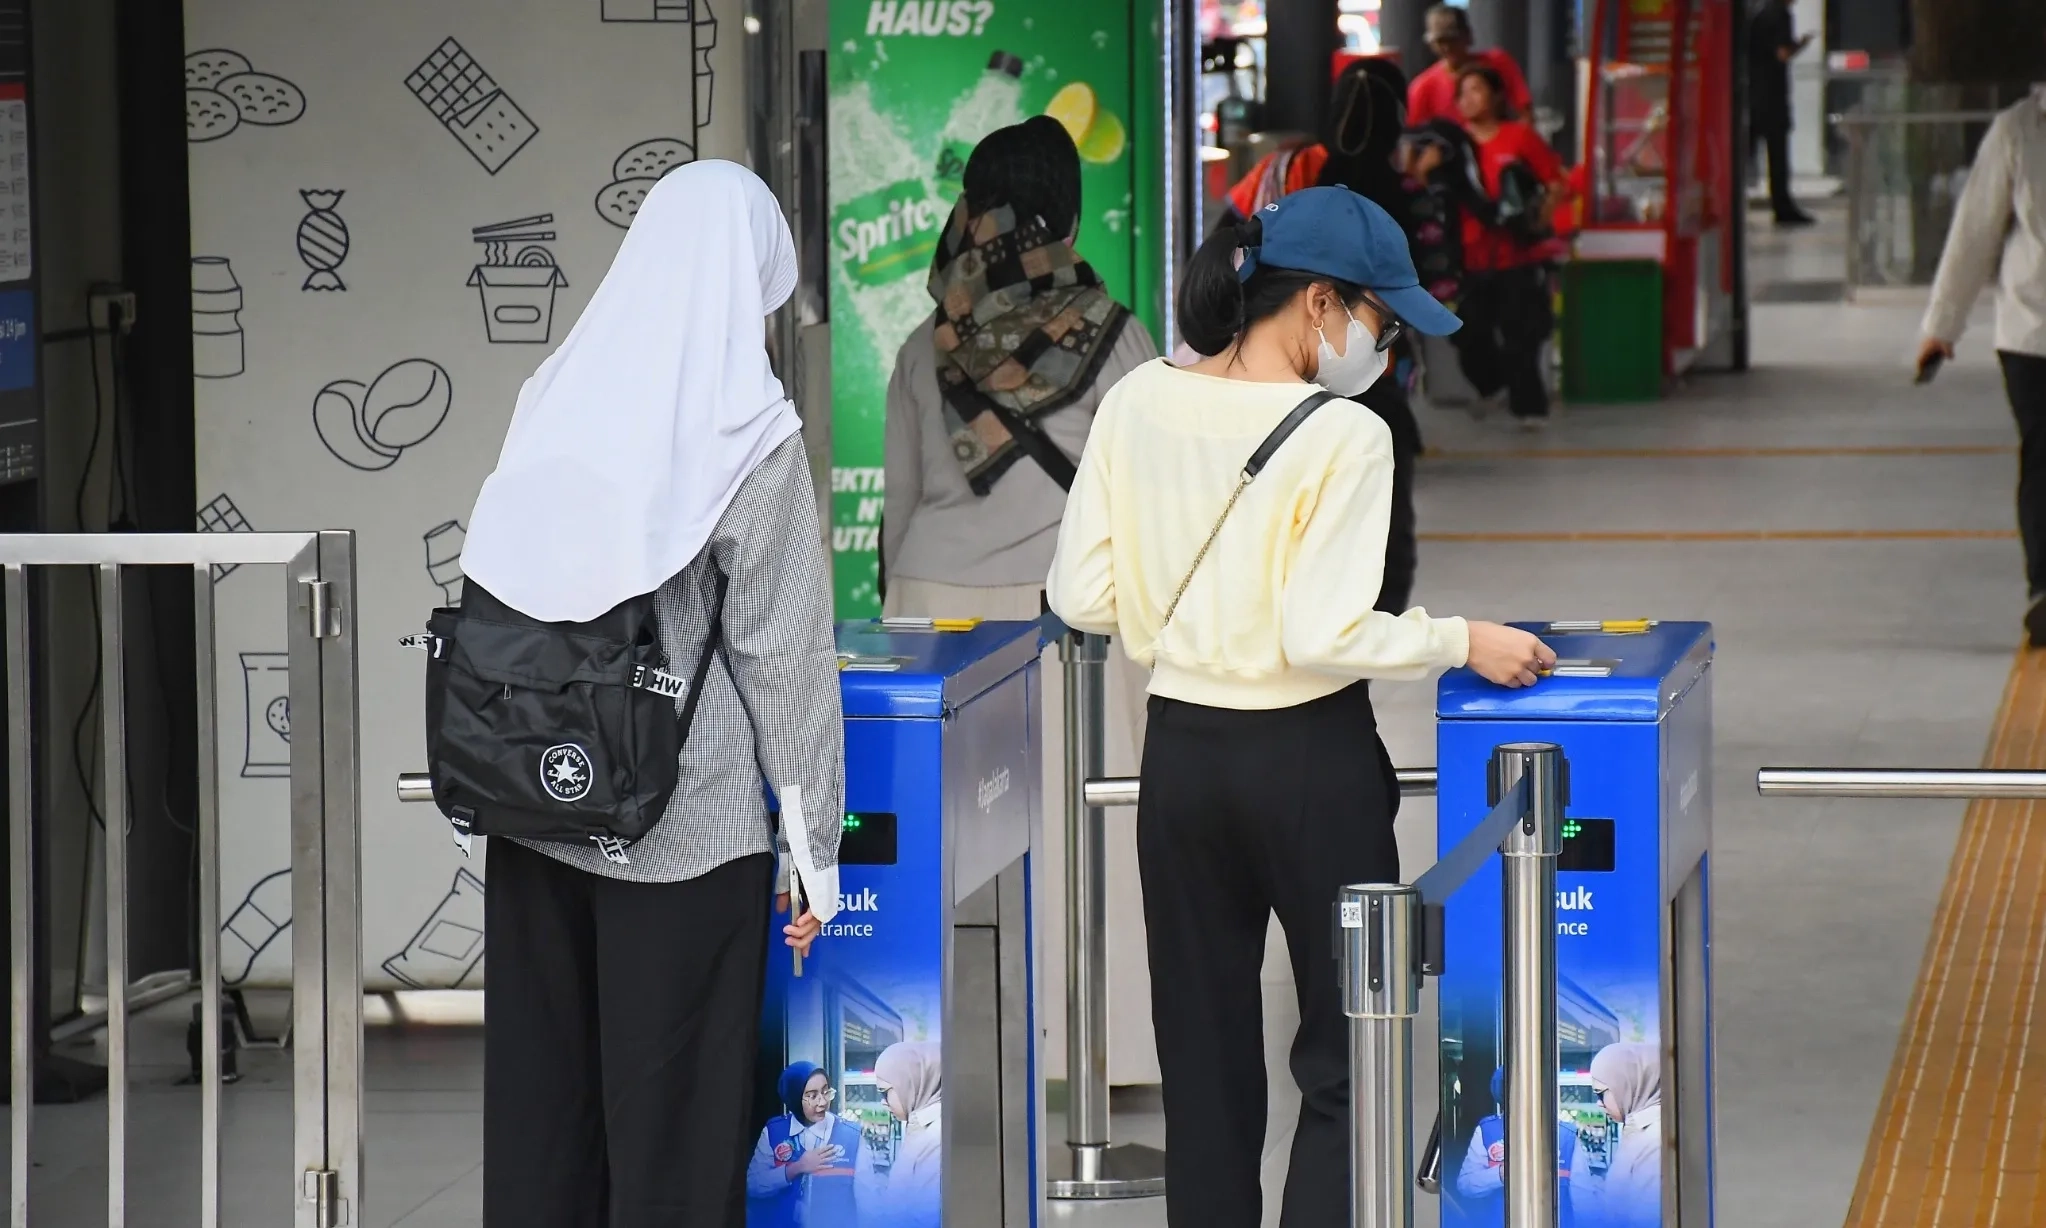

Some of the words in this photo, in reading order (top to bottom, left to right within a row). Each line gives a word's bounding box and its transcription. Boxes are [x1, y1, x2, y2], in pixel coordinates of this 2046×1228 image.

[865, 0, 994, 36] HAUS?
[838, 196, 932, 264] Sprite
[548, 748, 585, 768] CONVERSE
[550, 780, 563, 793] ALL
[564, 783, 583, 795] STAR
[815, 922, 873, 936] trance
[1557, 922, 1588, 935] nce
